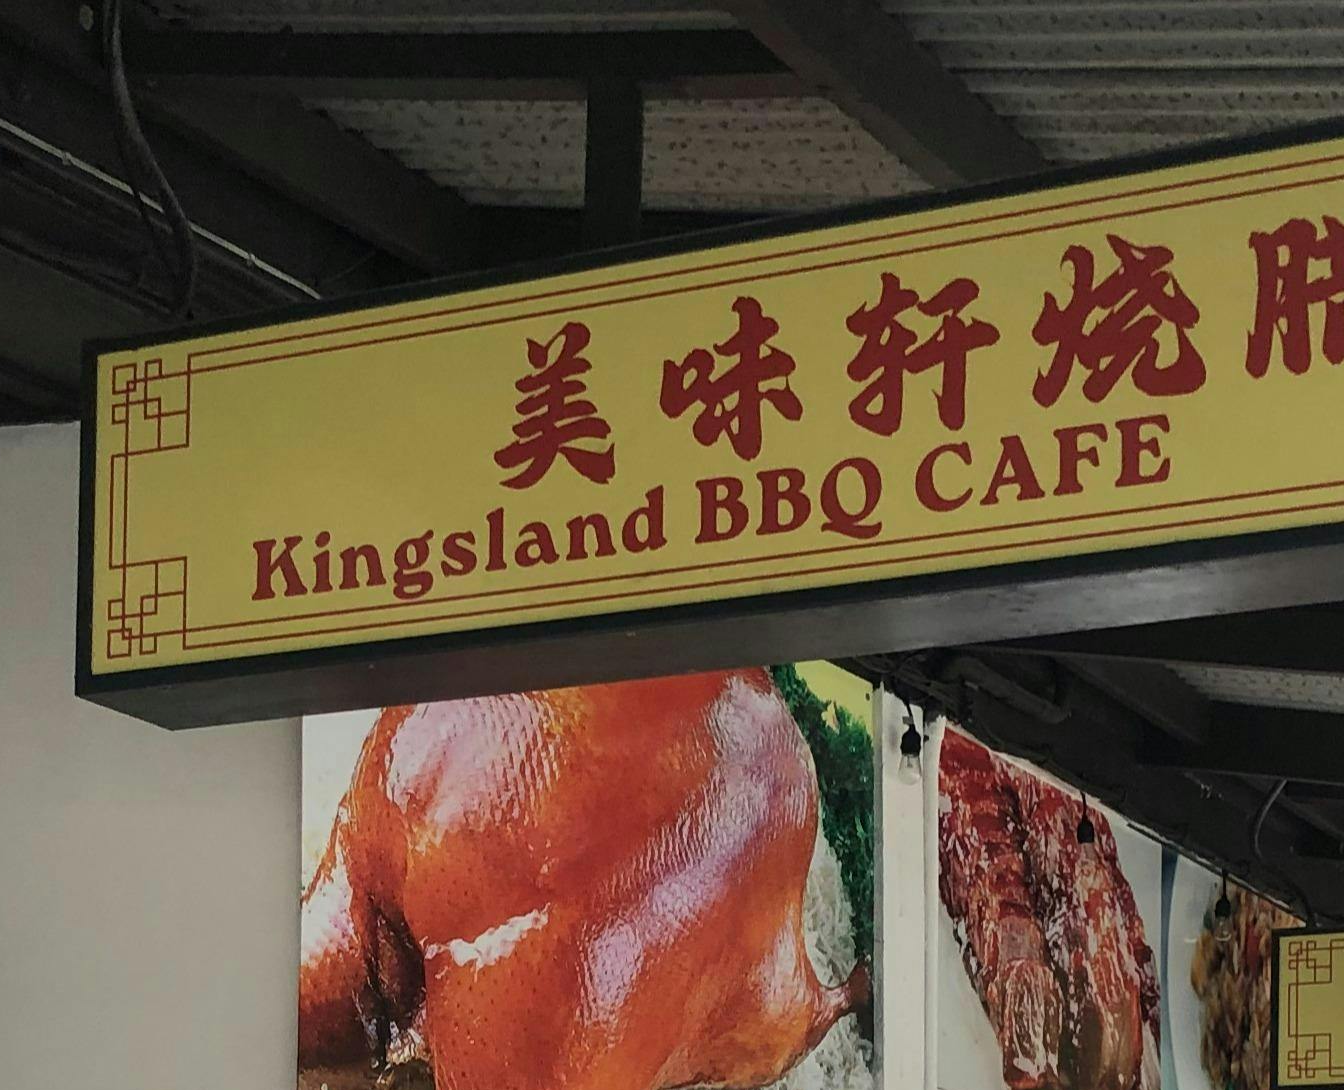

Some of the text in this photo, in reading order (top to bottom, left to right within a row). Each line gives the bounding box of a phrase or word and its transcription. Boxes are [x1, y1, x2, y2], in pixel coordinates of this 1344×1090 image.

[251, 414, 1172, 602] Kingsland BBQ CAFE
